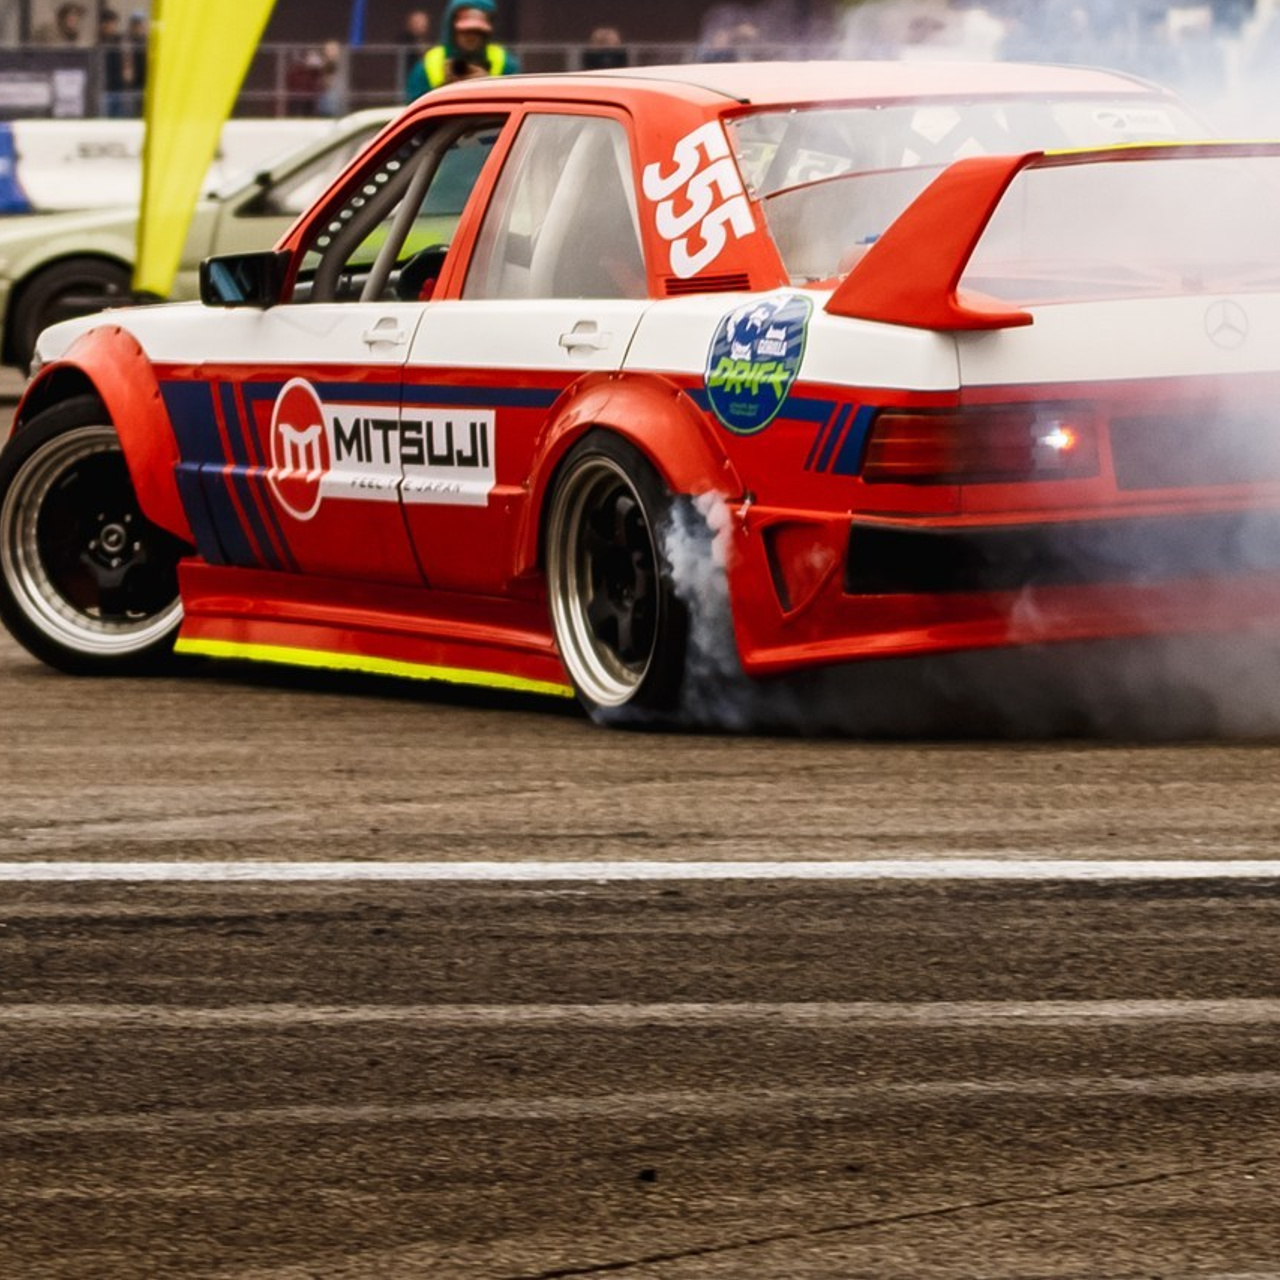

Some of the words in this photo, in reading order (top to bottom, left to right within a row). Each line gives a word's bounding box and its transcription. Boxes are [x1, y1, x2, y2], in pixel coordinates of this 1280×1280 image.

[642, 121, 755, 278] 555
[709, 356, 790, 399] DRIFT
[333, 417, 489, 468] MITSUJI
